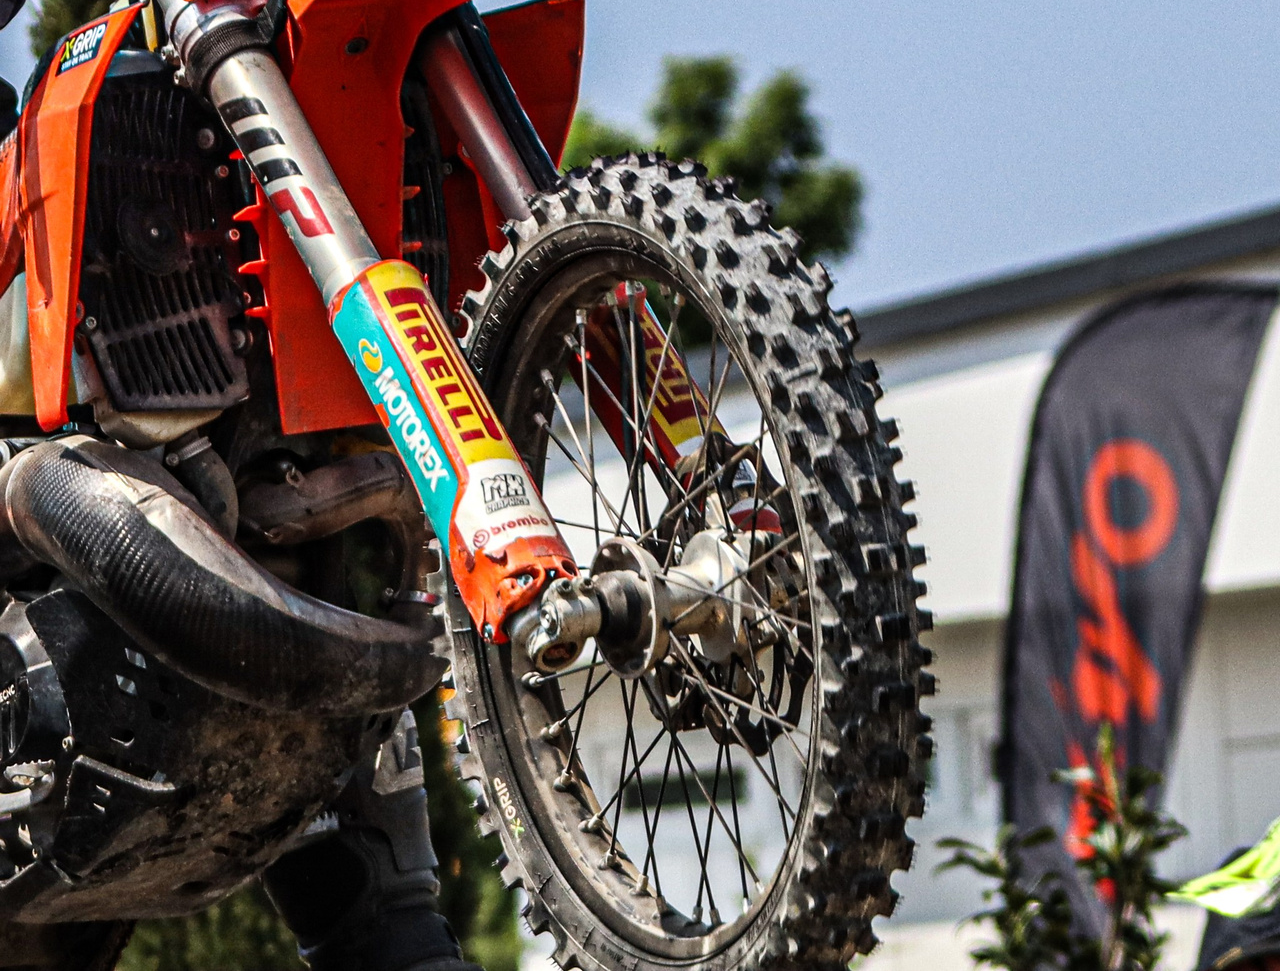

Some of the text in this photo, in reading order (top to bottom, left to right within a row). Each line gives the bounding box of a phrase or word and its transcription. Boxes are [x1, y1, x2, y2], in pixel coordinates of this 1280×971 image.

[383, 286, 504, 443] PIRELLI
[374, 365, 449, 493] MOTOREX
[480, 473, 526, 505] MX
[490, 514, 549, 537] brembo
